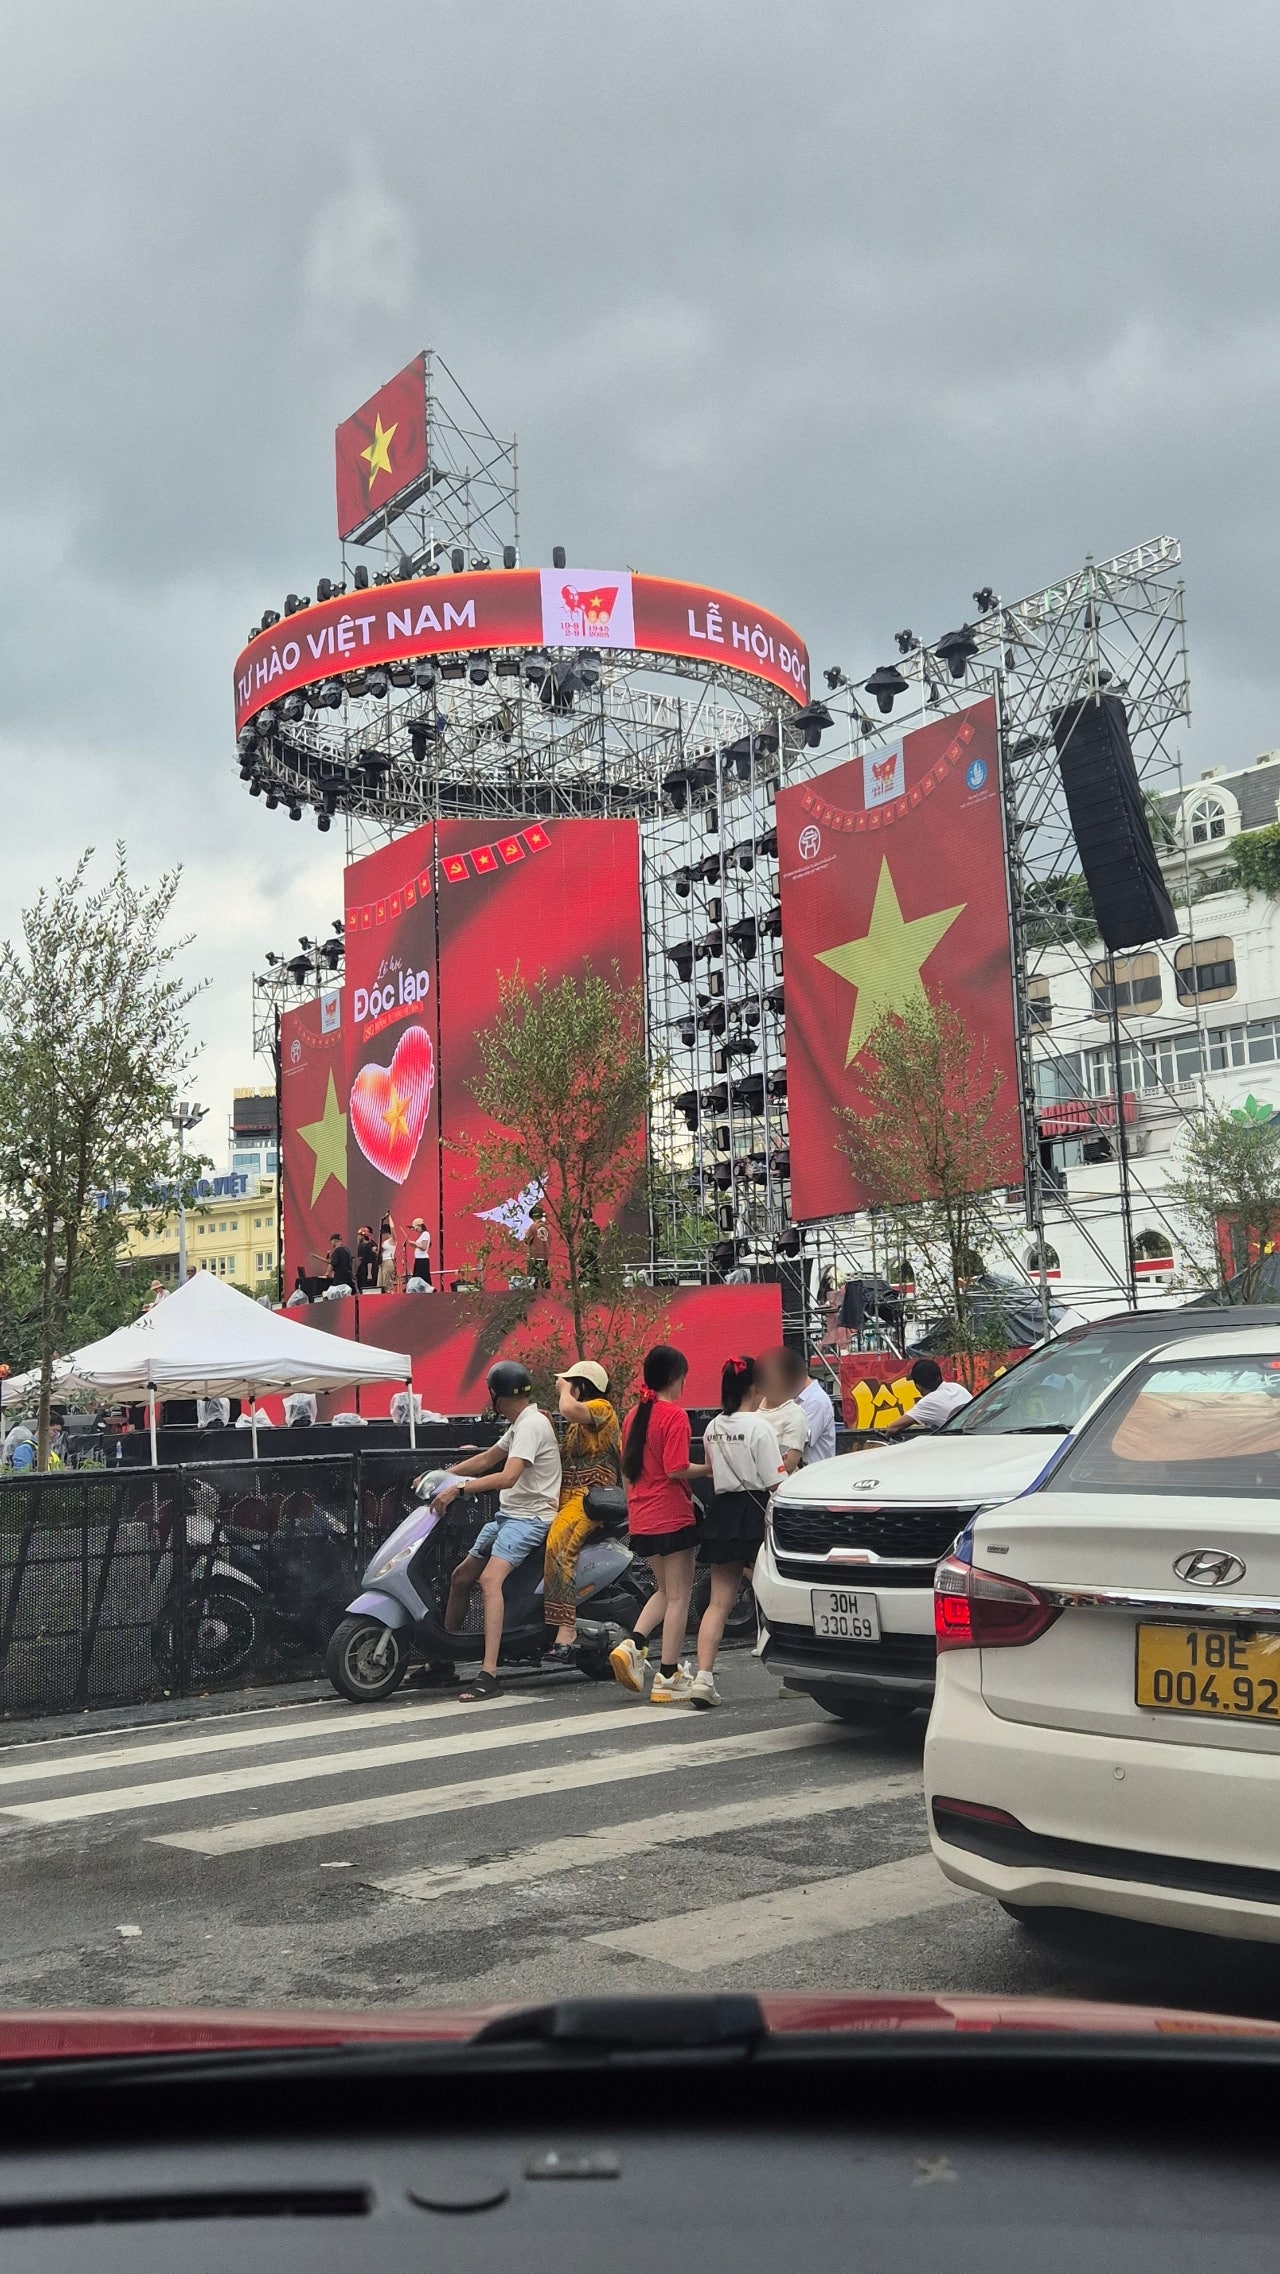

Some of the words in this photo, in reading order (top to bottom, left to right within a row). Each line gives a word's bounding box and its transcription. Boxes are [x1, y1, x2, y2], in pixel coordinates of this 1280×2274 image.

[237, 664, 252, 707] TỰ
[255, 641, 301, 689] HÀO
[306, 614, 376, 659] VIỆT
[386, 599, 476, 640] NAM
[687, 602, 725, 644] LỄ
[731, 621, 775, 665] HỘI
[354, 981, 395, 1023] Độc
[398, 967, 430, 1006] lập
[213, 1171, 249, 1198] VIỆT
[829, 1593, 859, 1615] 30H
[820, 1615, 872, 1638] 330.69
[1186, 1632, 1249, 1670] 18E
[1153, 1669, 1279, 1715] 004.92
